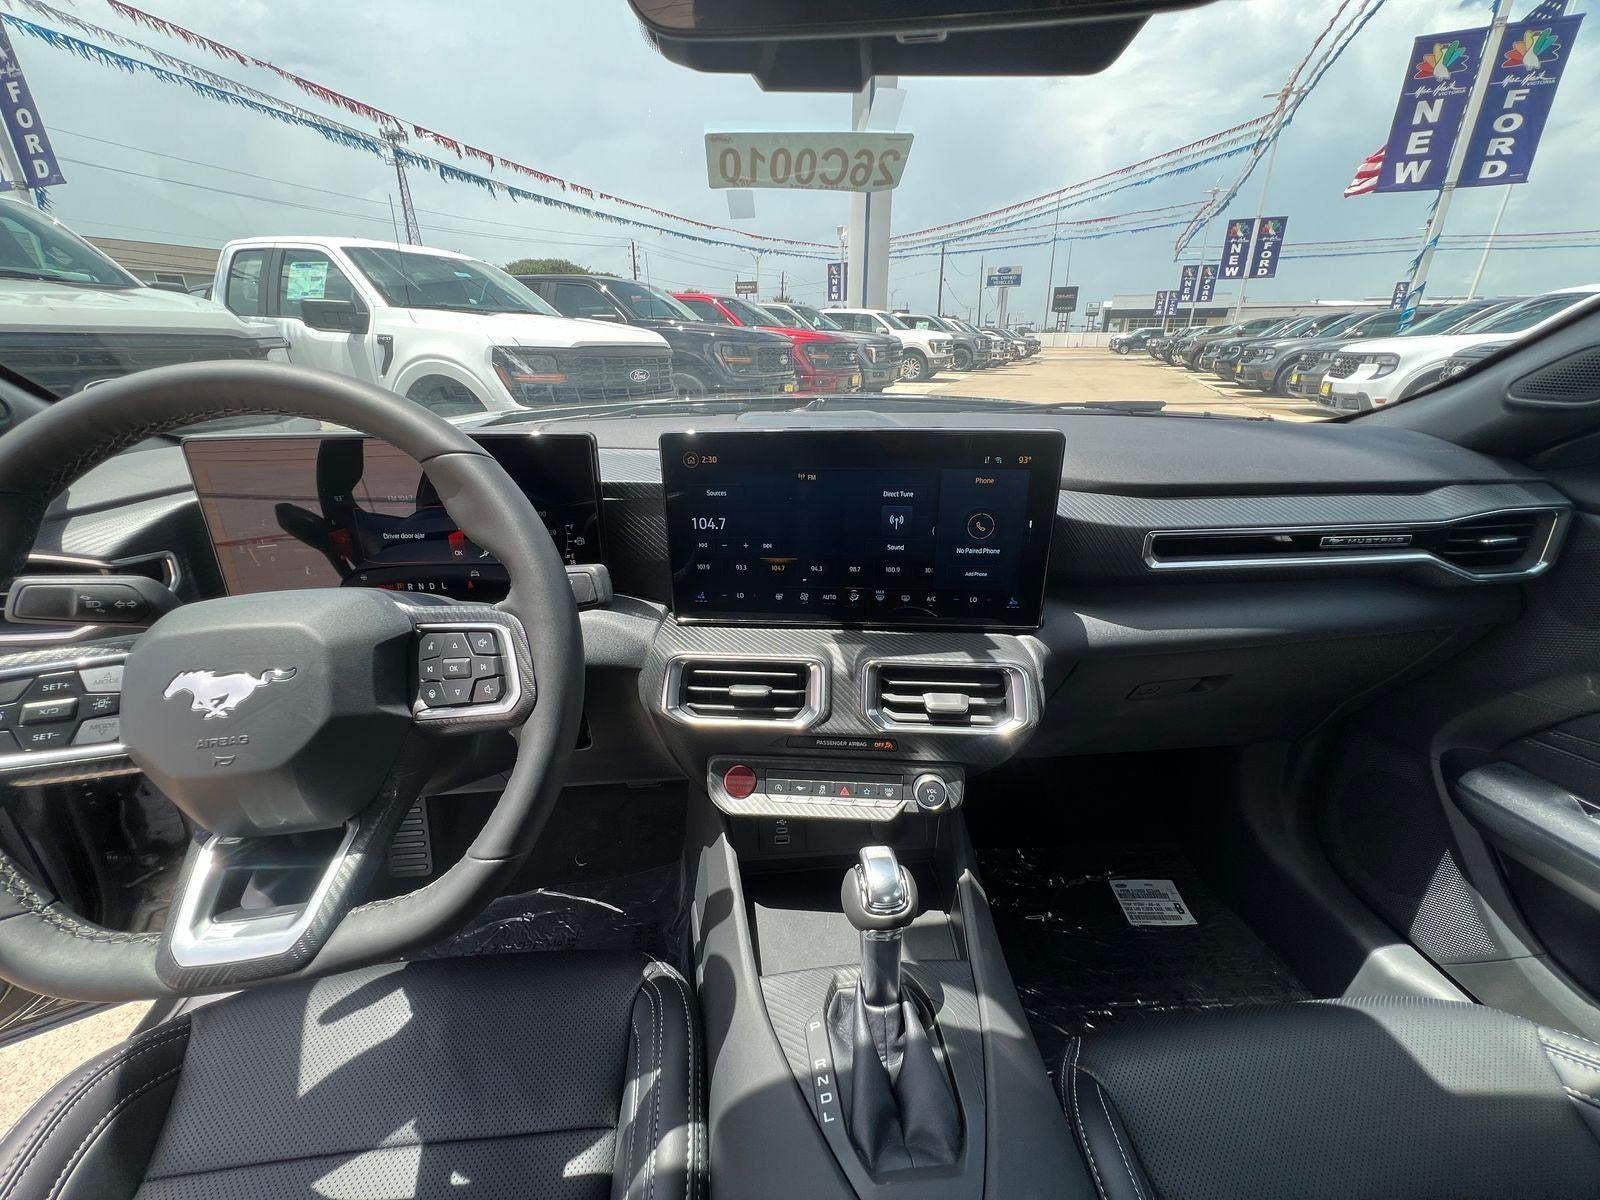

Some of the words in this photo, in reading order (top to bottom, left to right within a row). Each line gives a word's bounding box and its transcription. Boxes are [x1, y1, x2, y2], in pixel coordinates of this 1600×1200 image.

[6, 81, 50, 180] FORD
[1479, 88, 1530, 179] FORD
[1395, 98, 1444, 184] NEW
[1225, 243, 1242, 277] NEW
[1257, 241, 1273, 276] FORD
[831, 278, 839, 300] NEW
[1181, 280, 1192, 301] NEW
[1201, 279, 1211, 301] FORD
[701, 455, 718, 464] 2:30
[1018, 456, 1032, 464] 93°
[706, 489, 727, 497] Sources
[883, 490, 899, 498] Direct
[900, 490, 914, 498] Tune
[691, 517, 726, 530] 104.7
[89, 721, 118, 730] MODE
[196, 734, 249, 750] AIRBAG
[816, 739, 847, 747] PASSENGER
[809, 1021, 821, 1032] P
[814, 1058, 827, 1069] R
[817, 1074, 829, 1086] N
[820, 1092, 833, 1104] D
[823, 1111, 835, 1123] L
